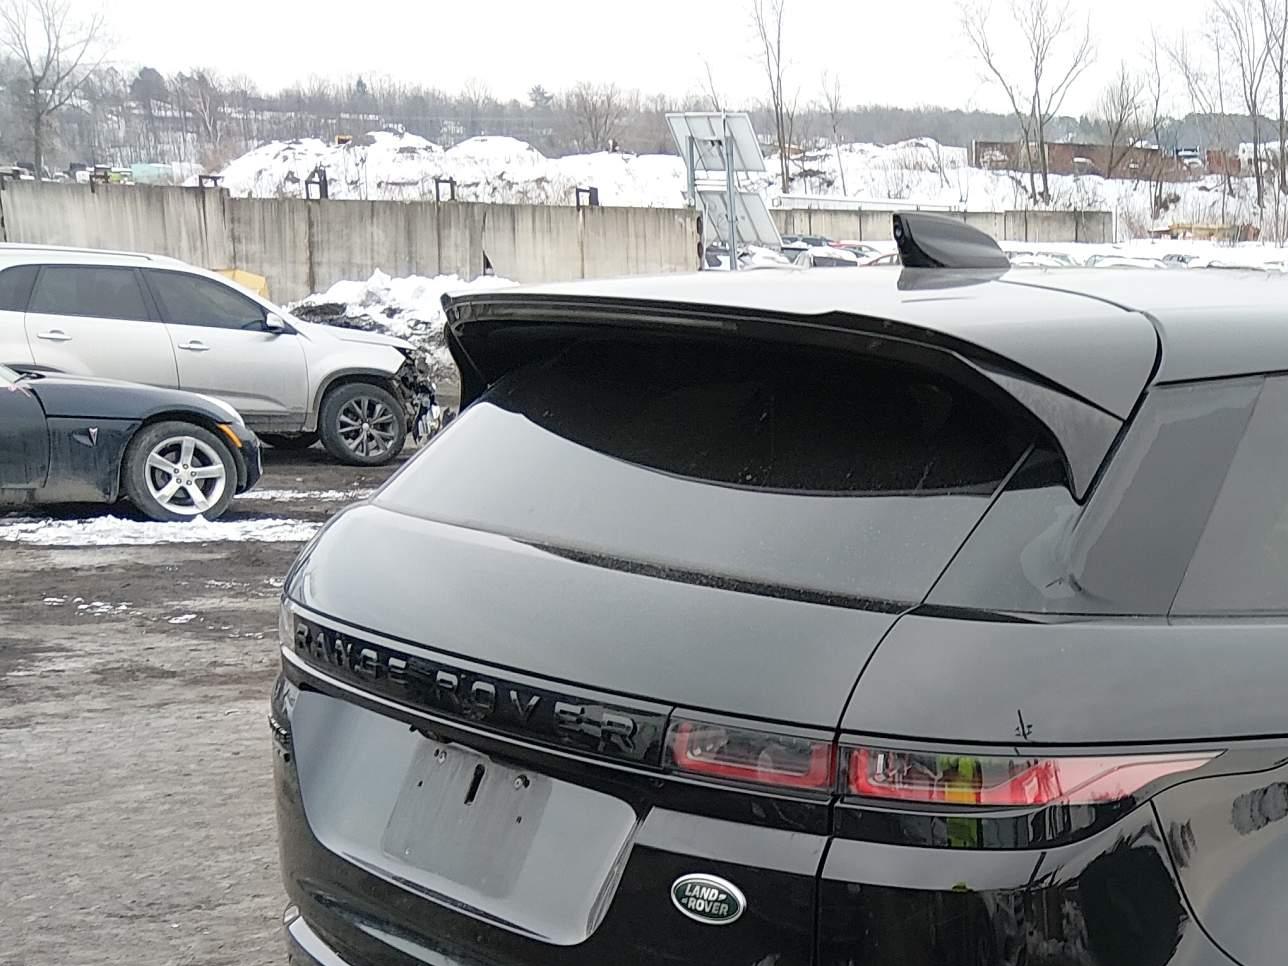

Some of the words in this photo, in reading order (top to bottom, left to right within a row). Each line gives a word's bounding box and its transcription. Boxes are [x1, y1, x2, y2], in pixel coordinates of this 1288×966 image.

[295, 622, 410, 686] RANGE
[435, 668, 638, 754] ROVER
[684, 883, 719, 902] LAND
[687, 897, 729, 916] ROVER
